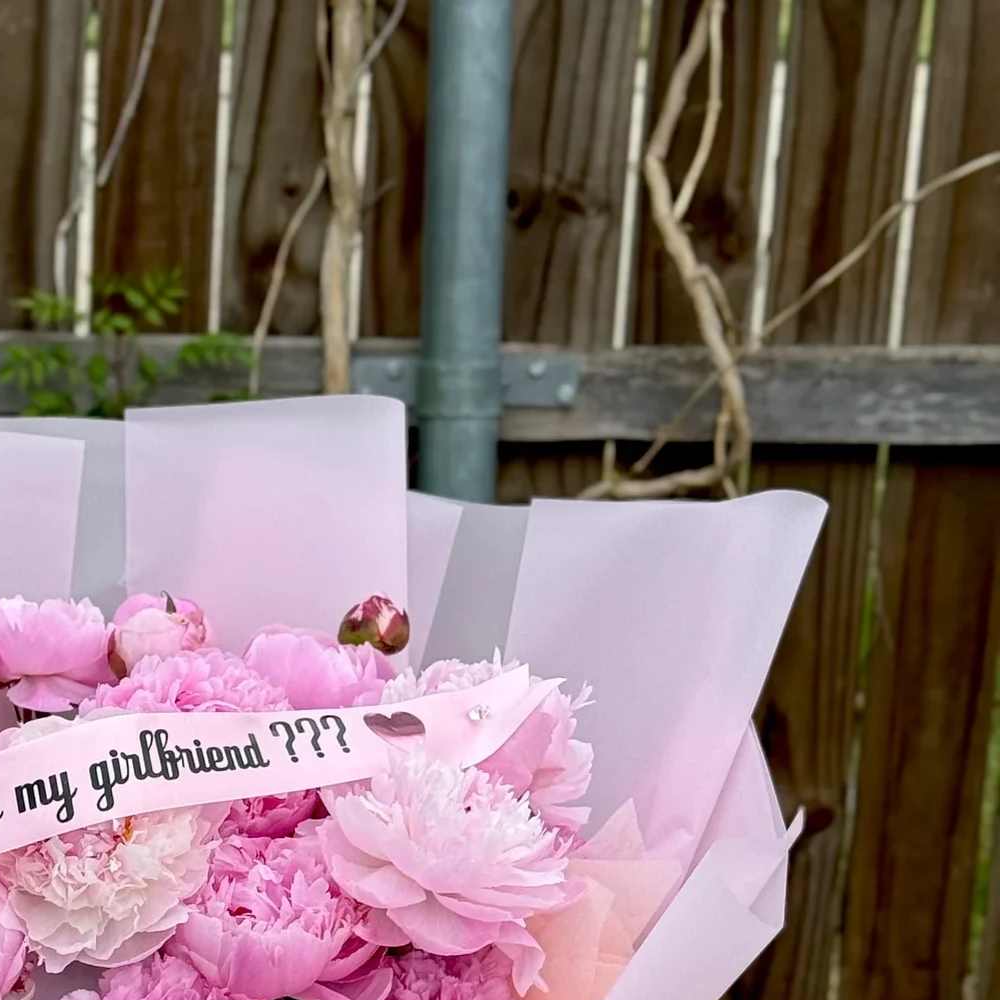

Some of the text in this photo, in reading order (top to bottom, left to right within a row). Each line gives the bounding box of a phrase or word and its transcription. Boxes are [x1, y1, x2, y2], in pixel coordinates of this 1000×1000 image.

[15, 772, 77, 823] my
[89, 729, 270, 811] girlfriend
[269, 713, 351, 764] ???
